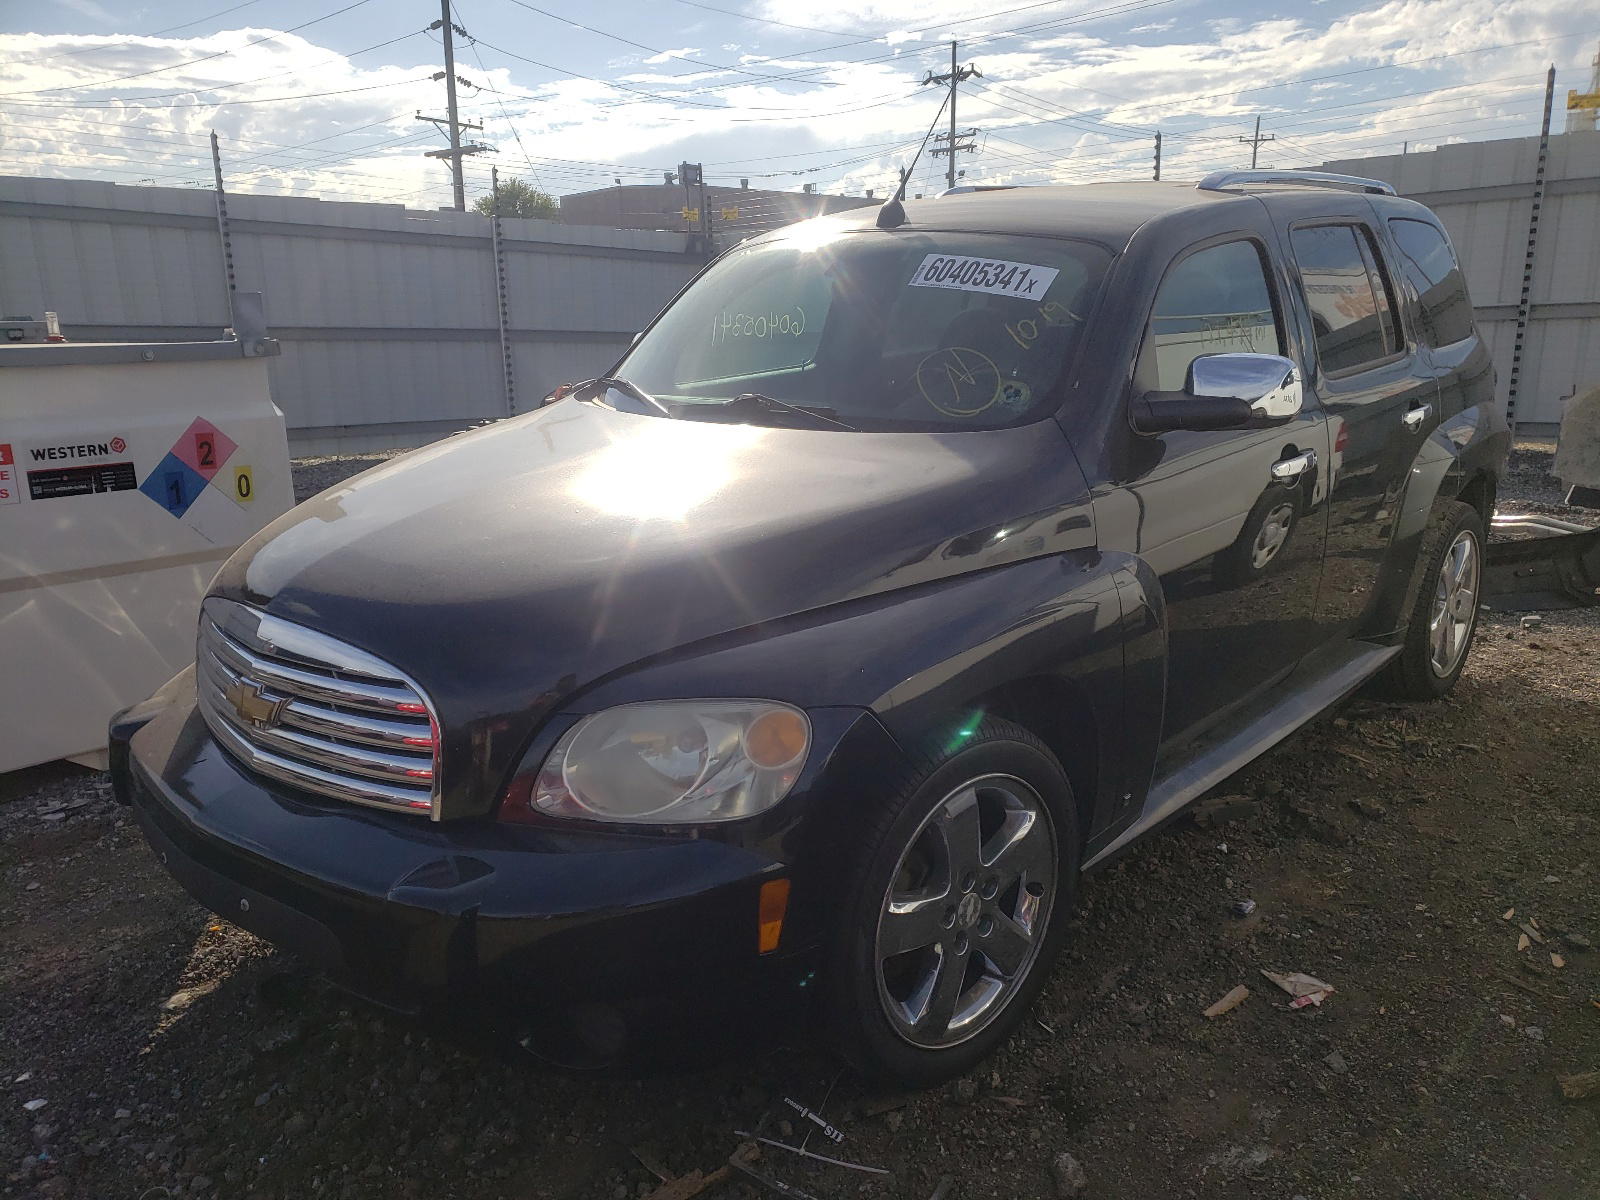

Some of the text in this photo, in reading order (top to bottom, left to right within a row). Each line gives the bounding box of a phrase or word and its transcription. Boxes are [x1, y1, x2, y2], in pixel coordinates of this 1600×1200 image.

[30, 443, 109, 461] WESTERN
[197, 441, 214, 466] 2
[169, 479, 182, 505] 1
[236, 473, 251, 498] 0
